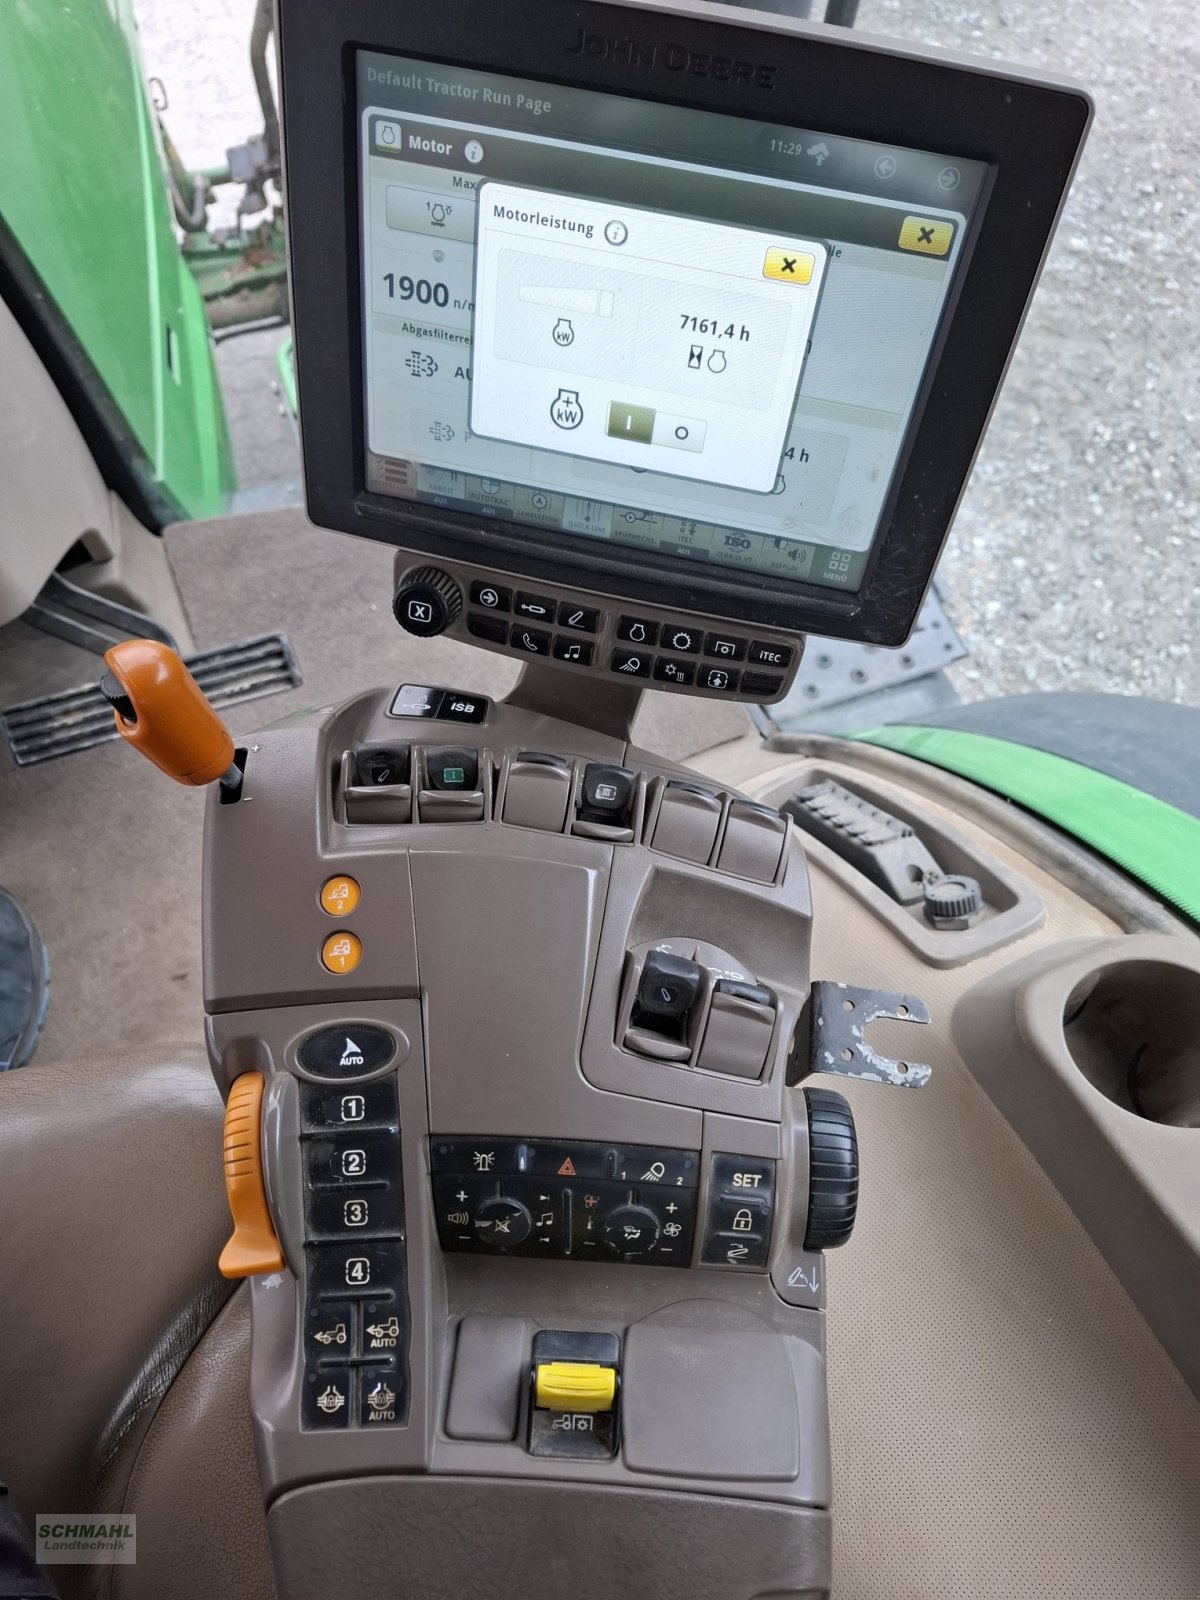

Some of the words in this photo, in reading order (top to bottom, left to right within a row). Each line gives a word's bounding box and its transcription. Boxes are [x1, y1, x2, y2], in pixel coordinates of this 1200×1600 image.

[367, 67, 422, 91] Default
[426, 78, 479, 101] Tractor
[483, 88, 511, 106] Run
[517, 94, 552, 115] Page
[409, 135, 452, 155] Motor
[769, 140, 802, 155] 11:29
[494, 205, 594, 238] Motorleistung
[382, 273, 449, 307] 1900
[681, 314, 734, 339] 7161,4
[740, 326, 750, 341] h
[556, 331, 570, 343] kW
[557, 405, 577, 423] kW
[799, 448, 809, 463] h
[469, 491, 509, 506] AUTOTRAC
[482, 507, 495, 515] AUS
[517, 510, 559, 523] LENKSYSTEM
[568, 521, 589, 530] QUICK
[591, 524, 605, 534] LINE
[723, 535, 751, 549] ISO
[677, 547, 691, 555] AUS
[717, 551, 742, 561] ISOBUS
[759, 649, 782, 663] iTEC
[450, 701, 475, 714] ISB
[337, 900, 343, 910] 2
[339, 1056, 364, 1066] AUTO
[348, 1100, 356, 1117] 1
[348, 1154, 360, 1171] 2
[621, 1171, 626, 1180] 1
[677, 1176, 683, 1185] 2
[732, 1173, 762, 1188] SET
[351, 1204, 362, 1221] 3
[351, 1262, 364, 1280] 4
[370, 1338, 397, 1348] AUTO
[369, 1411, 396, 1421] AUTO
